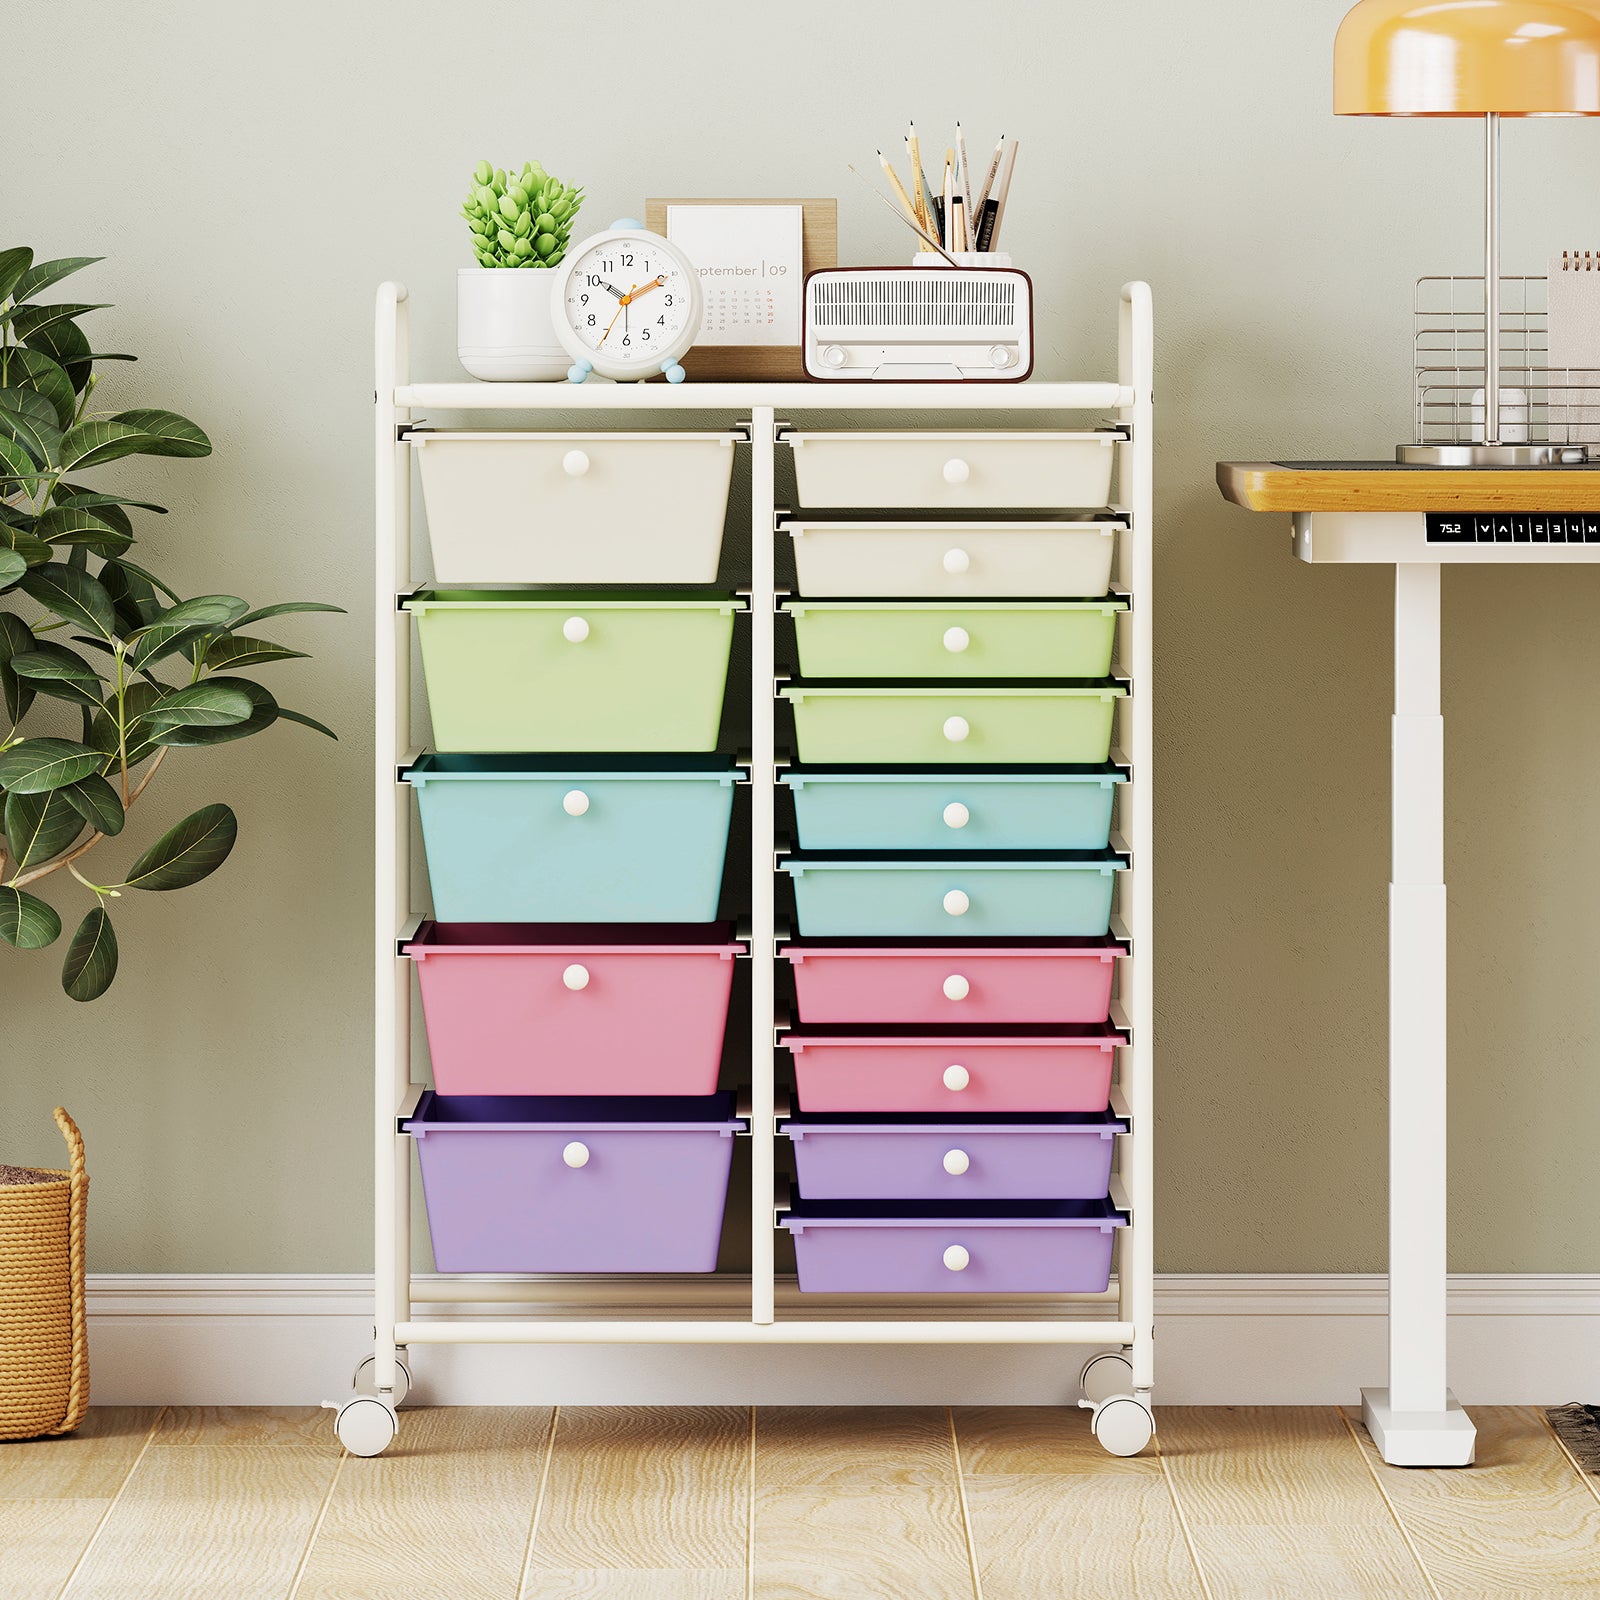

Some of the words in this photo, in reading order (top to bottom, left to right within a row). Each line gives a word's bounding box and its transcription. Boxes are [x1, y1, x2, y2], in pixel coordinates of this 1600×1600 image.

[620, 254, 634, 266] 12
[602, 261, 613, 272] 11
[645, 261, 649, 272] 1
[695, 266, 757, 277] eptember
[770, 266, 786, 276] 09
[586, 274, 600, 286] 10
[580, 294, 589, 306] 9
[665, 294, 673, 306] 3
[588, 314, 596, 326] 8
[657, 315, 665, 326] 4
[622, 334, 631, 346] 6
[642, 328, 650, 340] 5
[1440, 524, 1461, 533] 75.2
